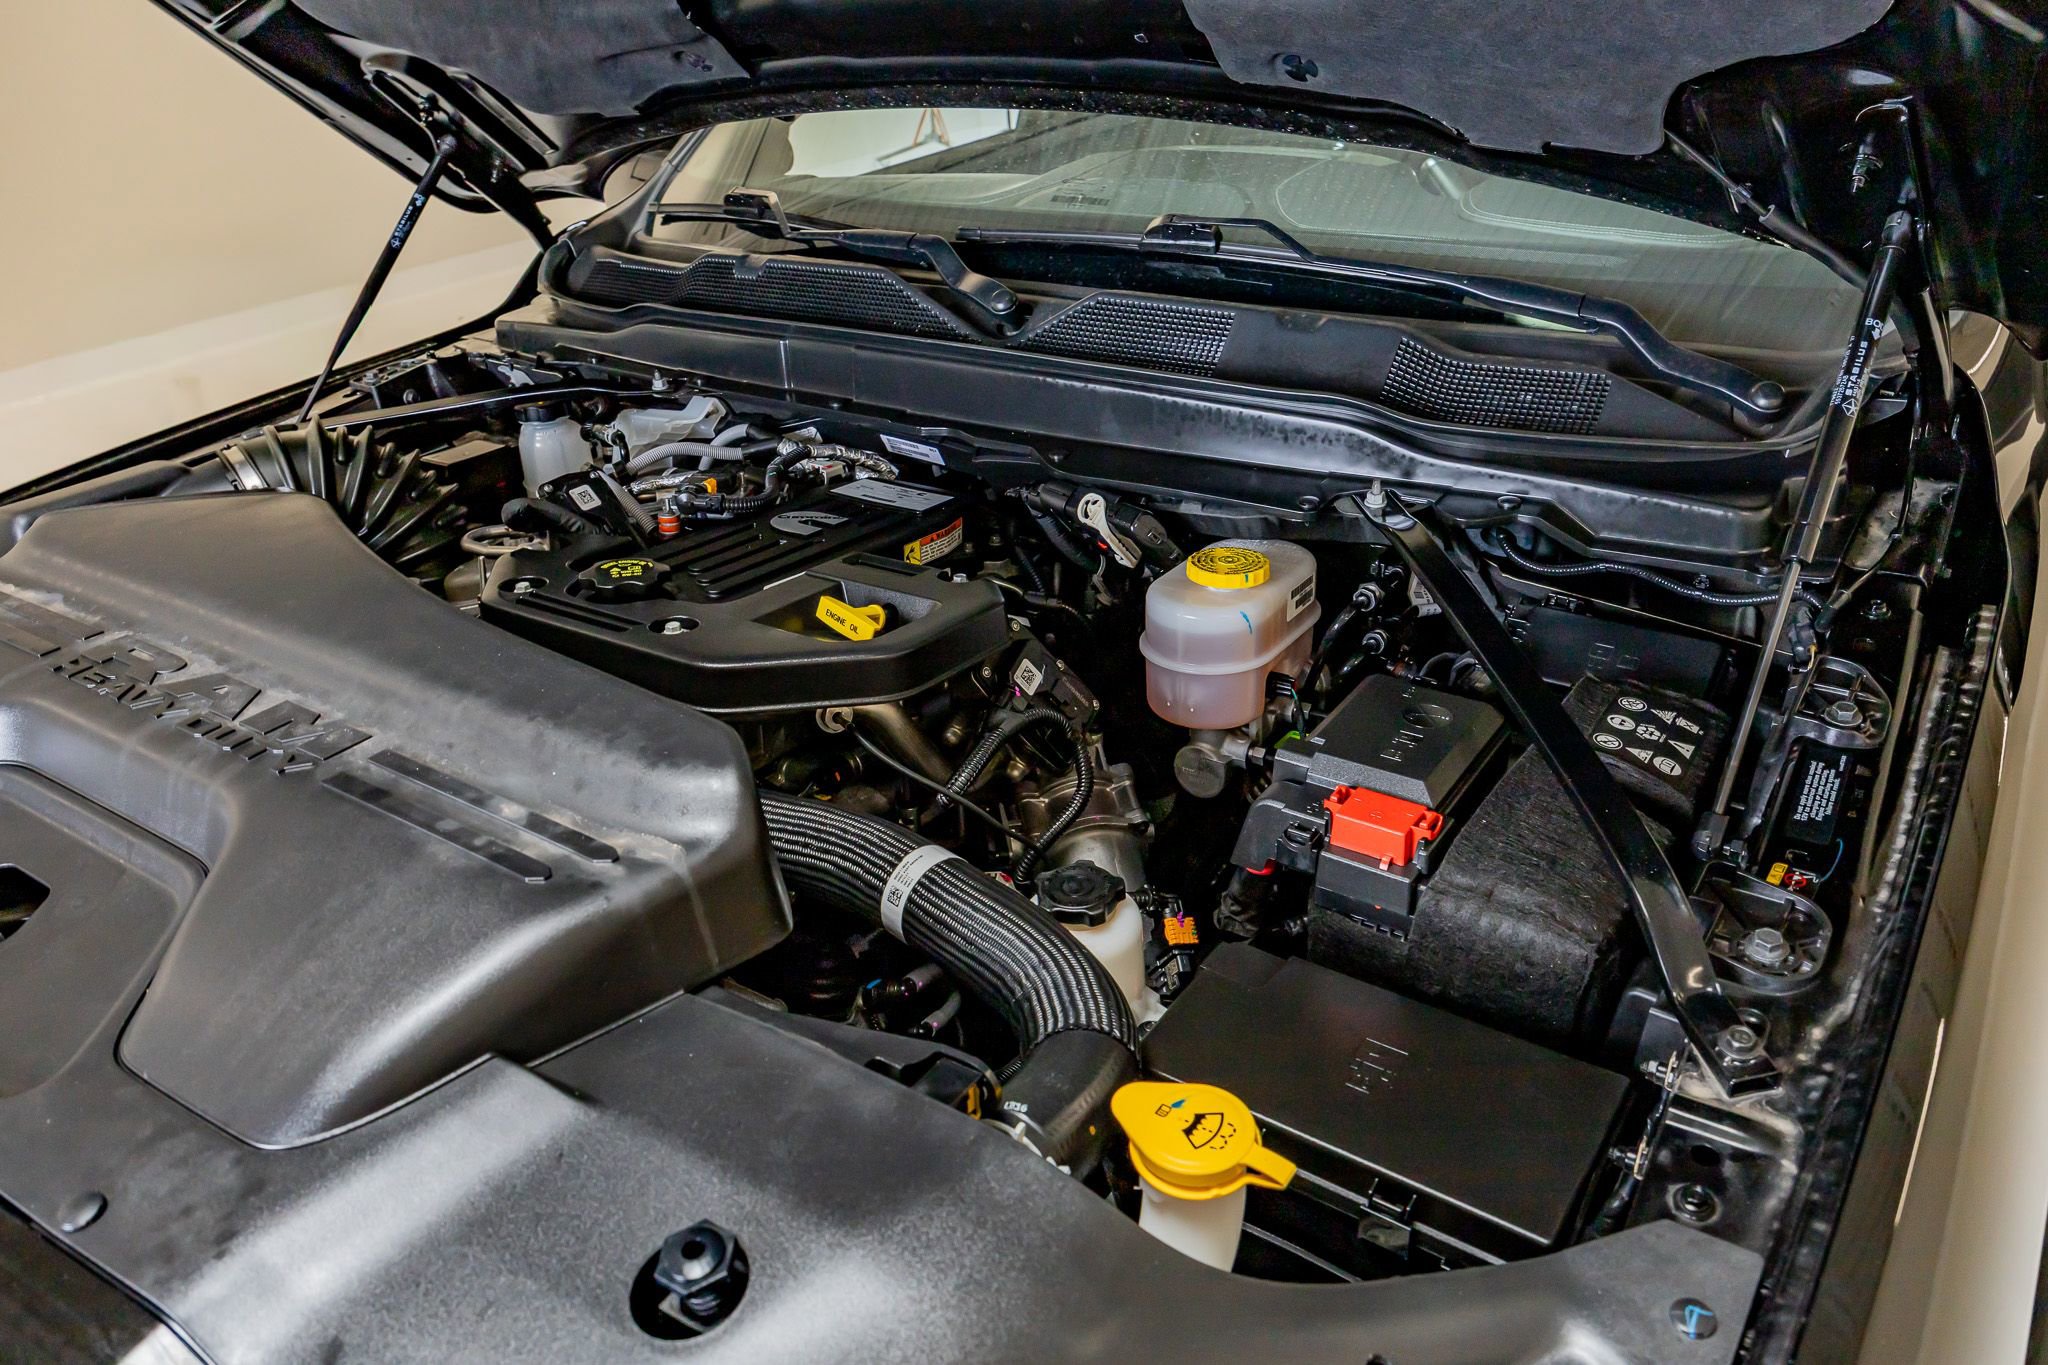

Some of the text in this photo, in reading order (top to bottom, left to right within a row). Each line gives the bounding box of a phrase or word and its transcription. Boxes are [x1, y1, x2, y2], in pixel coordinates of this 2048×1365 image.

[1845, 341, 1868, 396] STABILUS
[825, 608, 859, 635] ENGINE OIL
[51, 657, 315, 776] HEAVY DUTY
[80, 636, 373, 761] RAM
[1828, 769, 1836, 782] system
[1800, 812, 1808, 821] 12V
[1812, 774, 1820, 788] system
[1815, 807, 1825, 821] Engine
[1819, 799, 1827, 807] and
